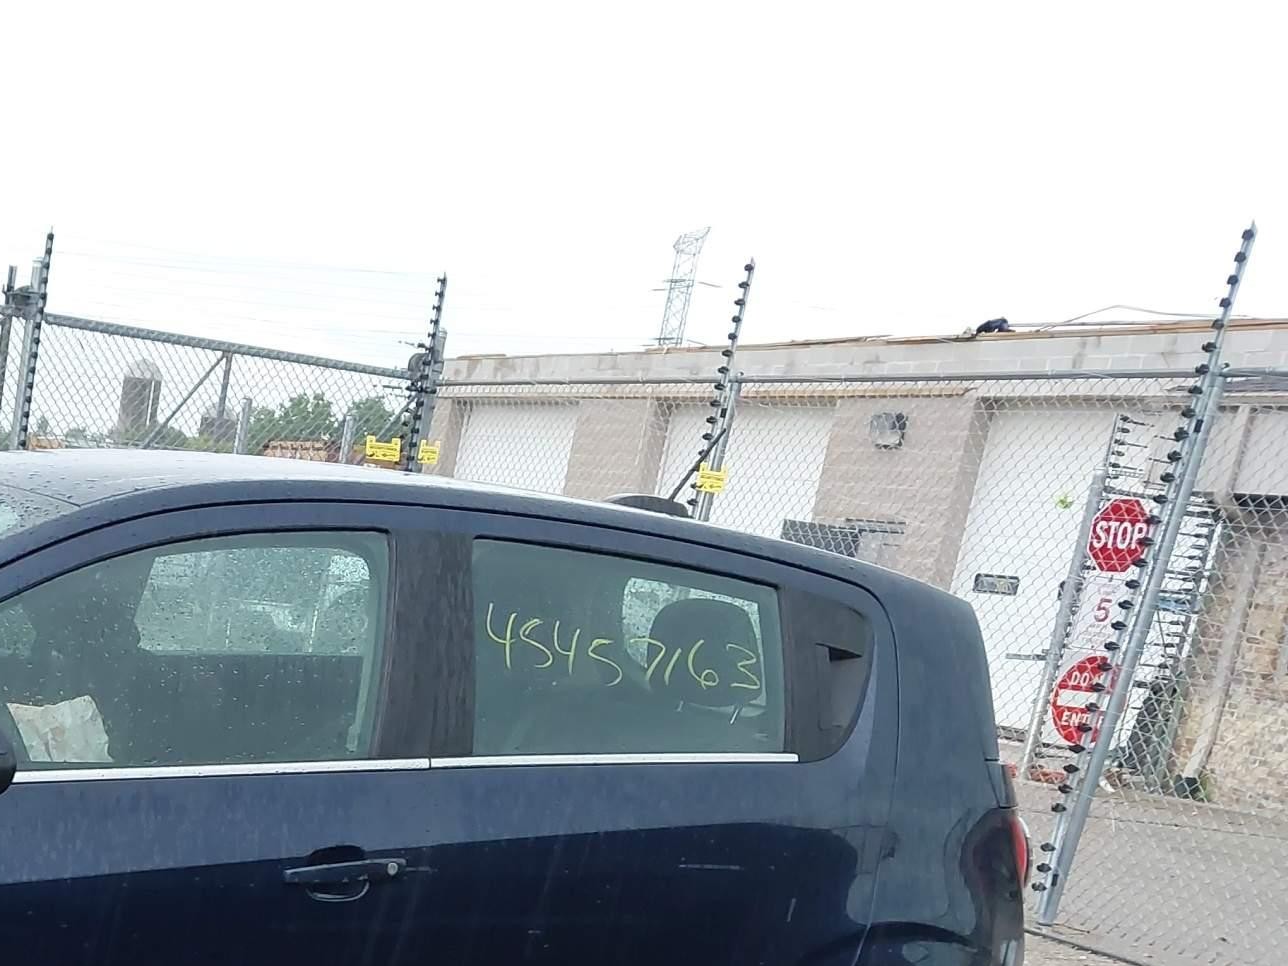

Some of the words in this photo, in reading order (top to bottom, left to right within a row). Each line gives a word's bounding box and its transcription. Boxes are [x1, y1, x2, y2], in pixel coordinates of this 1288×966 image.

[1092, 520, 1148, 549] STOP
[1094, 598, 1113, 622] 5
[486, 602, 762, 690] 45457163
[1071, 671, 1090, 686] DO
